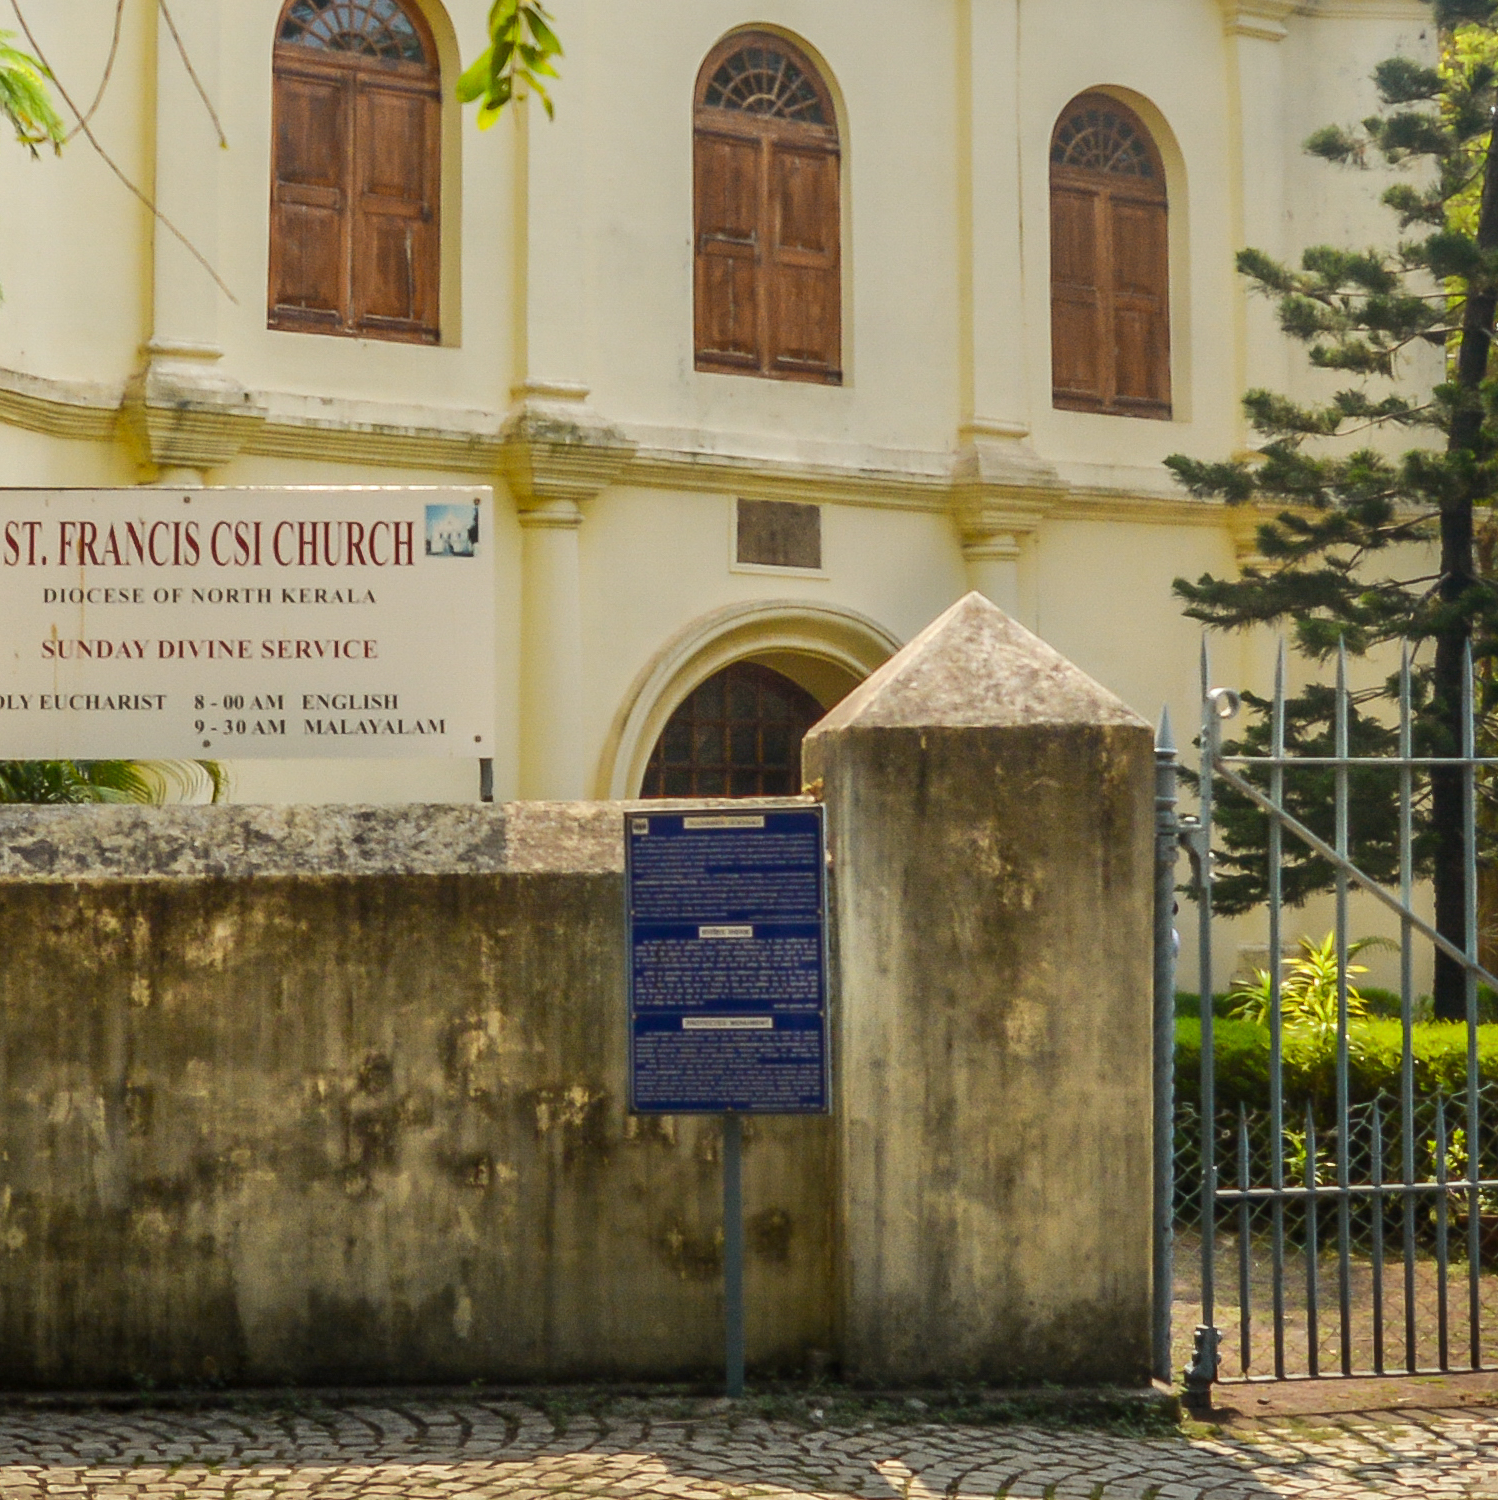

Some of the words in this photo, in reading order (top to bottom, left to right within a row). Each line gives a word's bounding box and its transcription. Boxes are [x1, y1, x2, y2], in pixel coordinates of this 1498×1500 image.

[4, 520, 48, 567] ST.
[59, 520, 201, 567] FRANCIS
[210, 520, 262, 567] CSI
[273, 520, 415, 567] CHURCH
[43, 587, 145, 605] DIOCESE
[153, 587, 183, 605] OF
[191, 587, 271, 605] NORTH
[281, 587, 377, 605] KERALA
[41, 639, 149, 660] SUNDAY
[157, 639, 253, 660] DIVINE
[261, 639, 379, 660] SERVICE
[39, 693, 168, 711] EUCHARIST
[250, 693, 285, 711] AM
[302, 693, 399, 711] ENGLISH
[252, 718, 287, 736] AM
[303, 718, 447, 736] MALAYALAM
